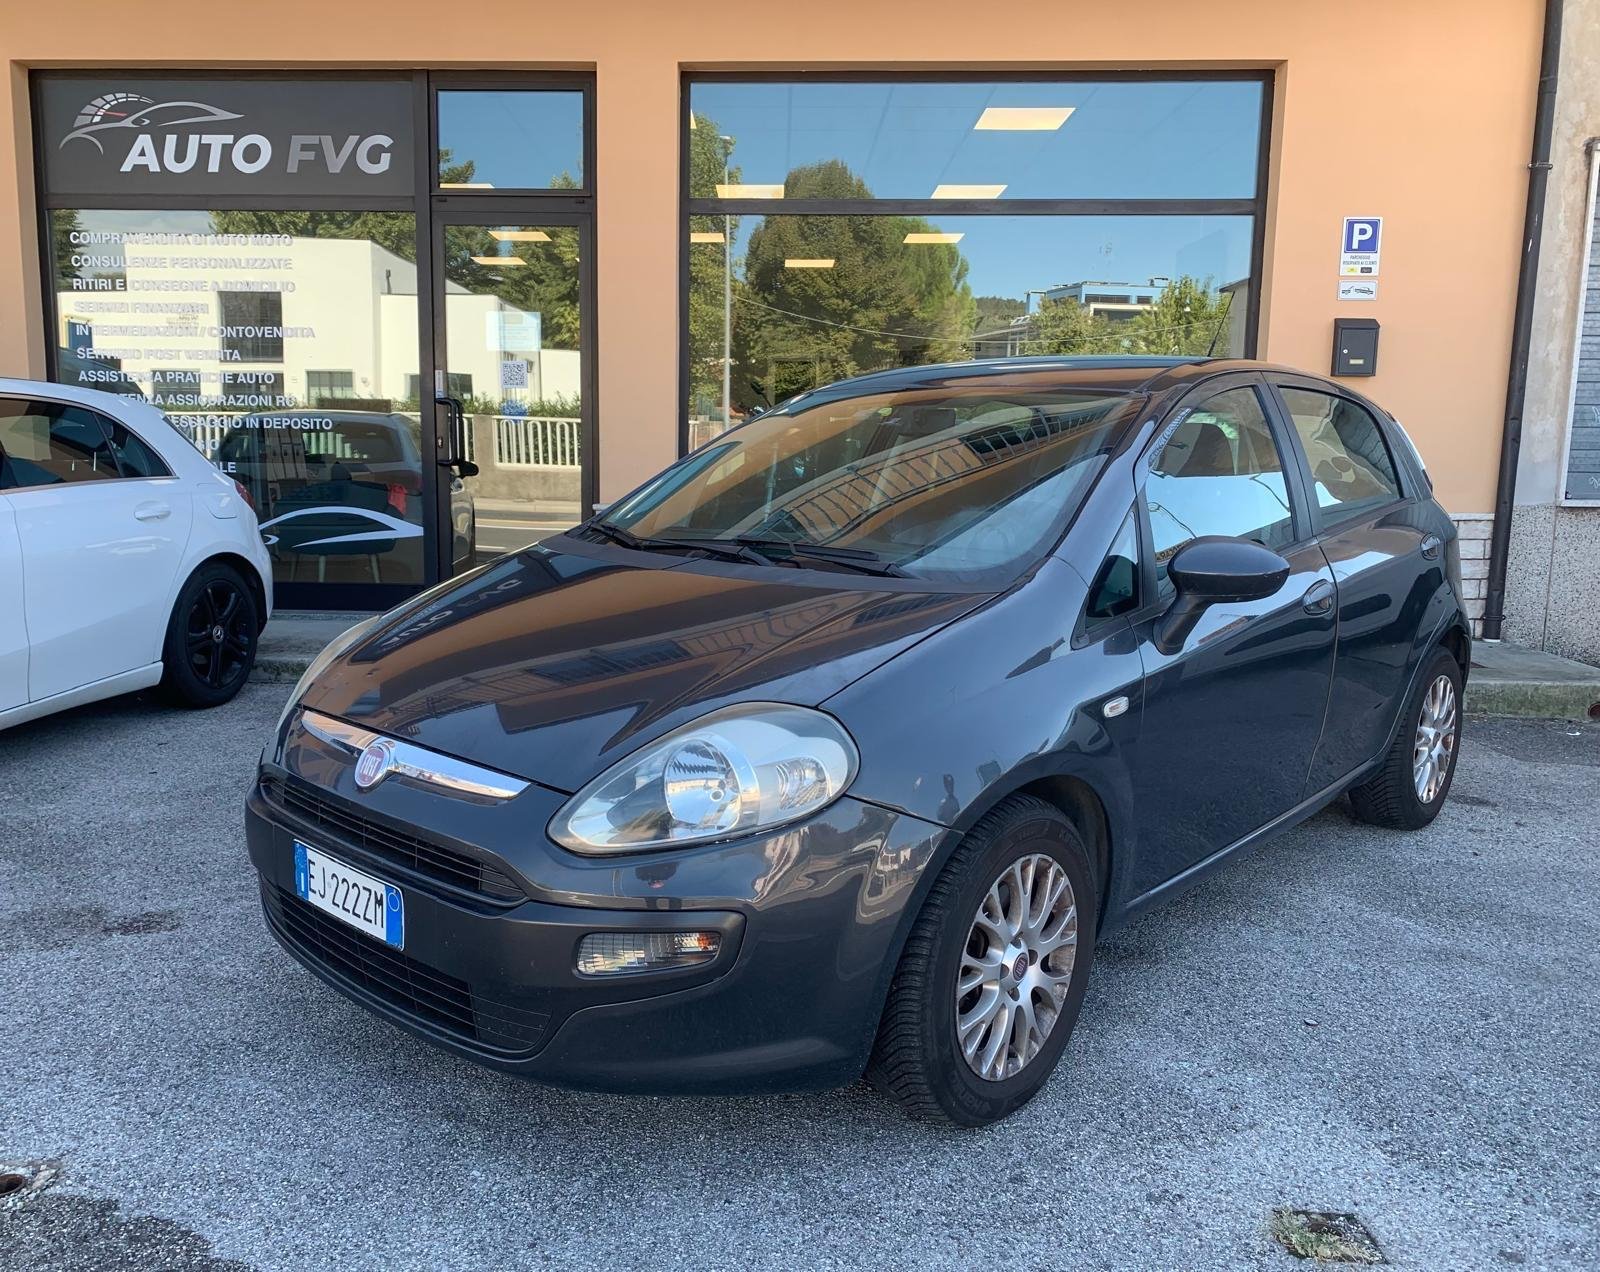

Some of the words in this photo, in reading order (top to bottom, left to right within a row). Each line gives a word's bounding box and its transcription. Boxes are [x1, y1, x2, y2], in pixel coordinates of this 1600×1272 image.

[119, 133, 272, 174] AUTO
[287, 133, 394, 175] FVG
[69, 232, 191, 246] COMPRAVENDITA
[192, 234, 206, 246] DI
[207, 234, 249, 247] AUTO
[251, 234, 293, 247] MOTO
[1351, 223, 1373, 249] P
[71, 255, 168, 269] CONSULENZE
[171, 257, 293, 270] PERSONALIZZATE
[73, 278, 112, 291] RITIRI
[115, 279, 125, 291] E
[128, 280, 208, 292] CONSEGNE
[208, 280, 219, 292] A
[221, 280, 296, 293] DOMICILIO
[73, 301, 129, 313] SERVIZI
[76, 324, 197, 337] INTERMEDIAZIONI
[207, 326, 315, 338] CONTOVENDITA
[76, 347, 143, 360] SERVIZIO
[144, 348, 181, 361] POST
[184, 349, 241, 361] VENDITA
[78, 370, 163, 383] ASSISTENZA
[166, 371, 234, 384] PRATICHE
[238, 372, 275, 384] AUTO
[167, 394, 272, 406] ASSICURAZIONI
[169, 414, 243, 429] ESSAGGIO
[245, 417, 259, 429] IN
[262, 417, 333, 430] DEPOSITO
[359, 753, 382, 778] FIAT
